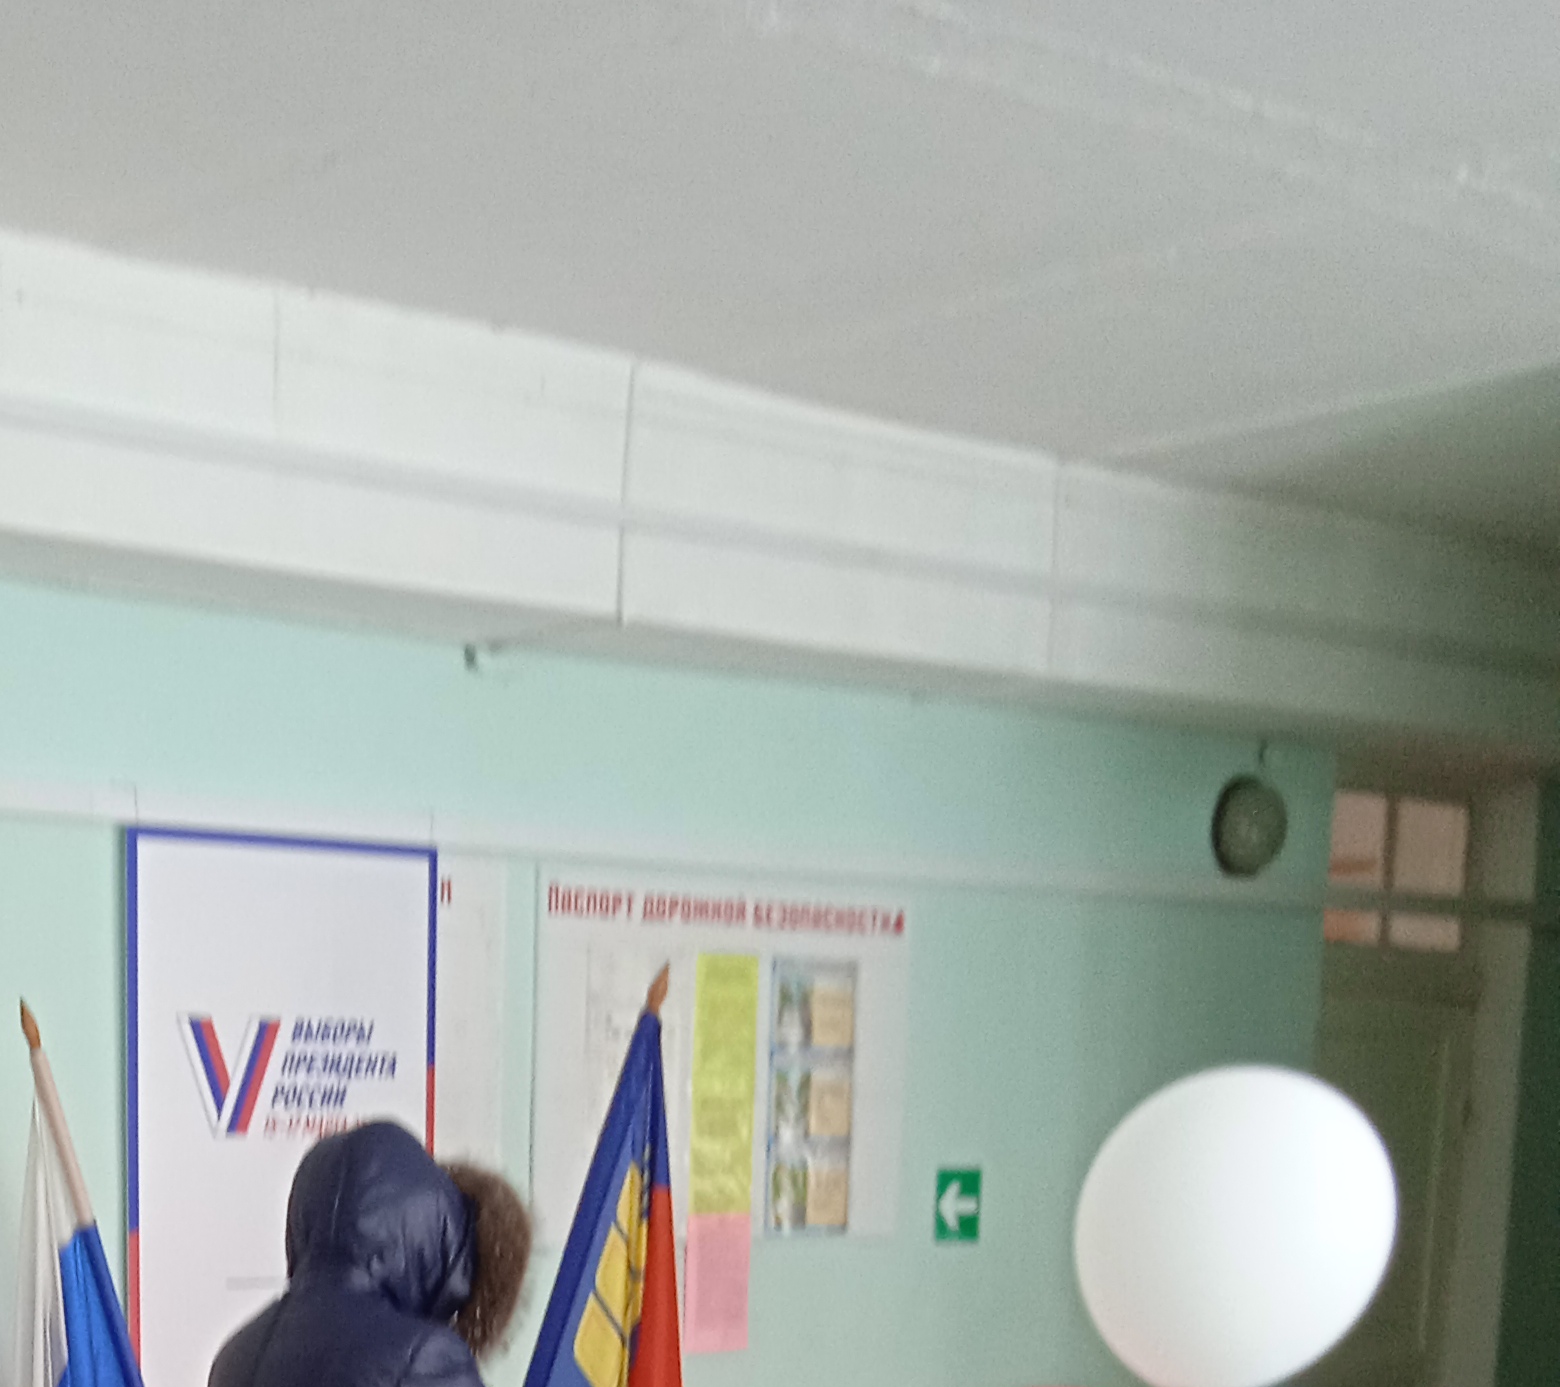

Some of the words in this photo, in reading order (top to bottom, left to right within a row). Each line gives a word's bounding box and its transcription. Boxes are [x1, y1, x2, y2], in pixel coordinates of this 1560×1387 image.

[291, 1016, 375, 1045] ВЫБОРЫ
[280, 1050, 398, 1081] ПРЕЗИДЕНТА
[271, 1082, 348, 1111] РОССИИ
